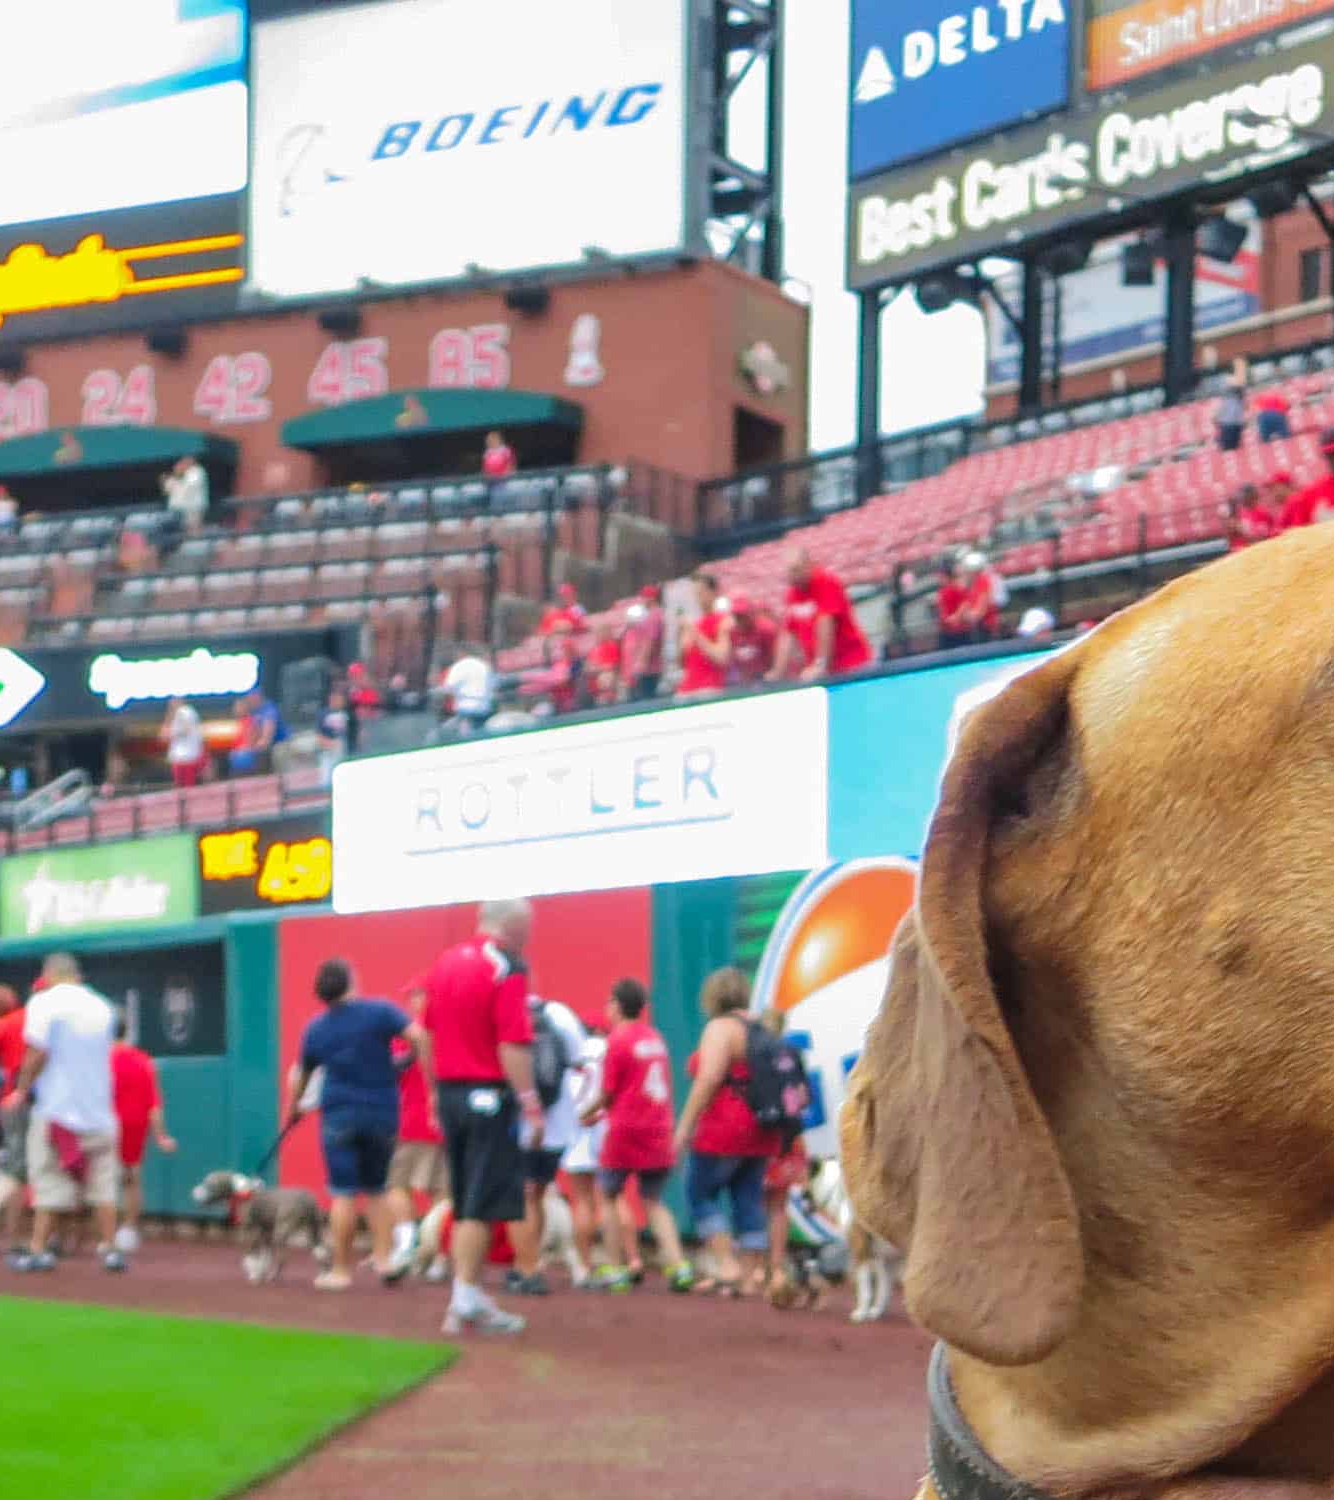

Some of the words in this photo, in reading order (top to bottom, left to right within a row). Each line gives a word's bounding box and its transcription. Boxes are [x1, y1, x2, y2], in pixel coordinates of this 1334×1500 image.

[902, 0, 1066, 80] DELTA
[1118, 6, 1197, 66] Saint
[369, 82, 663, 162] BOEING
[857, 172, 958, 264] Best
[82, 363, 156, 426] 24
[194, 351, 272, 425] 42
[307, 336, 389, 406] 45
[414, 743, 720, 832] ROTTLER
